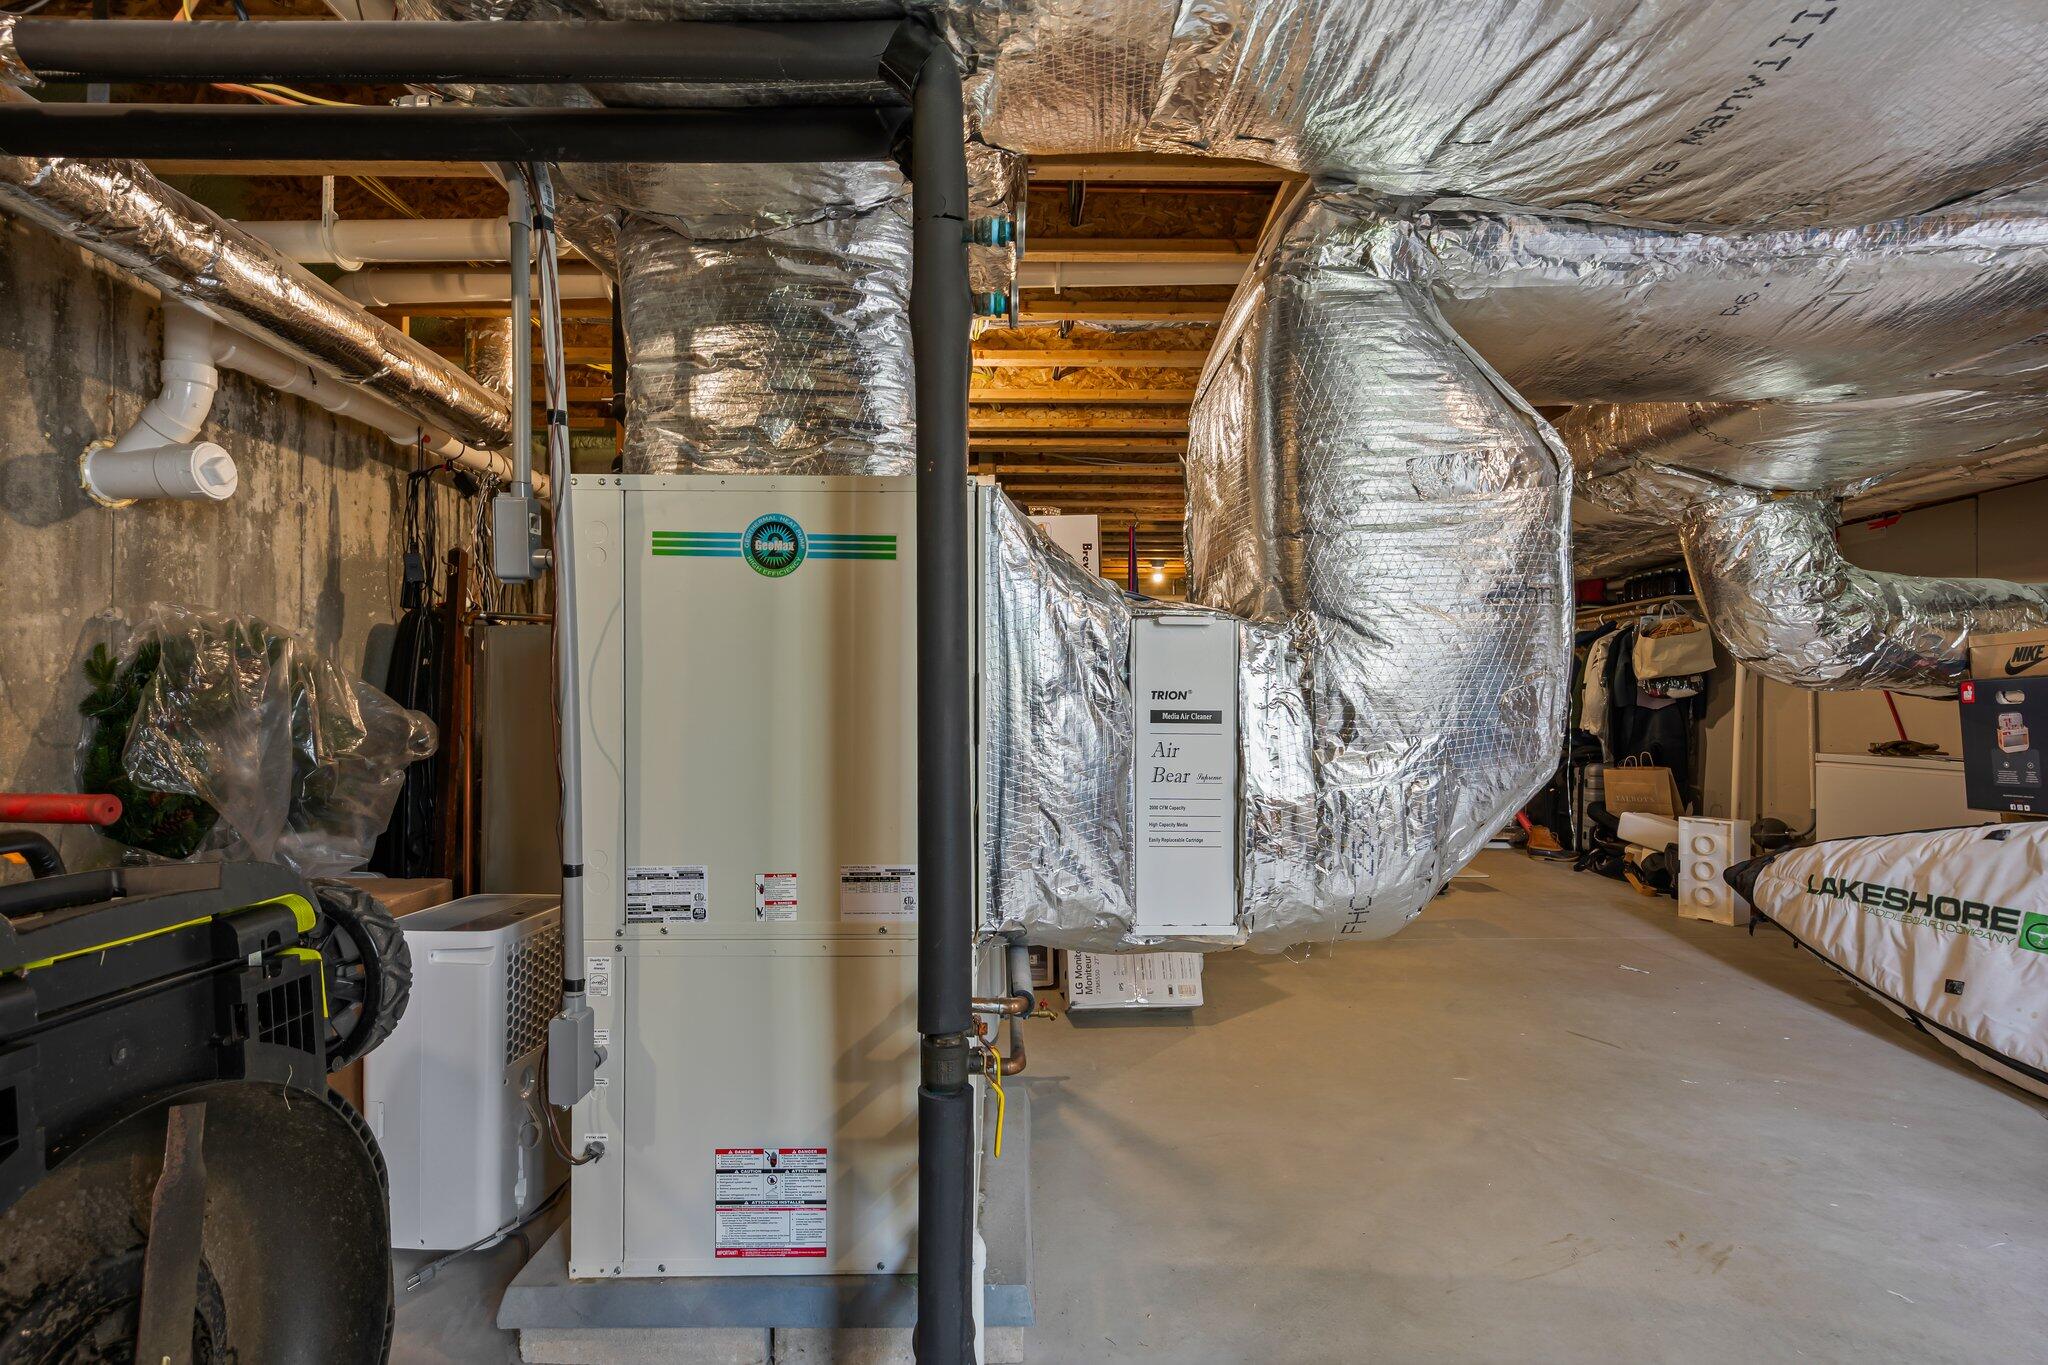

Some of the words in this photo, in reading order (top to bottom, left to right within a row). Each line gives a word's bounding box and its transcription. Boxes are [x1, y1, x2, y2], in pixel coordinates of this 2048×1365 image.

[1674, 0, 1838, 146] Manvill
[754, 539, 795, 551] GeoMax
[1082, 543, 1092, 572] Brev
[2010, 644, 2046, 663] NIKE
[1162, 712, 1180, 720] Media
[1180, 712, 1190, 720] Air
[1190, 712, 1213, 720] Cleaner
[1151, 741, 1180, 758] Air
[1152, 766, 1191, 783] Bear
[1340, 895, 1372, 934] FHC
[1806, 873, 2022, 935] LAKESHORE
[1862, 905, 1944, 932] PADDLEBOARD
[1945, 923, 2017, 946] COMPANY
[1084, 954, 1093, 995] Moniteur
[1075, 982, 1084, 995] LG
